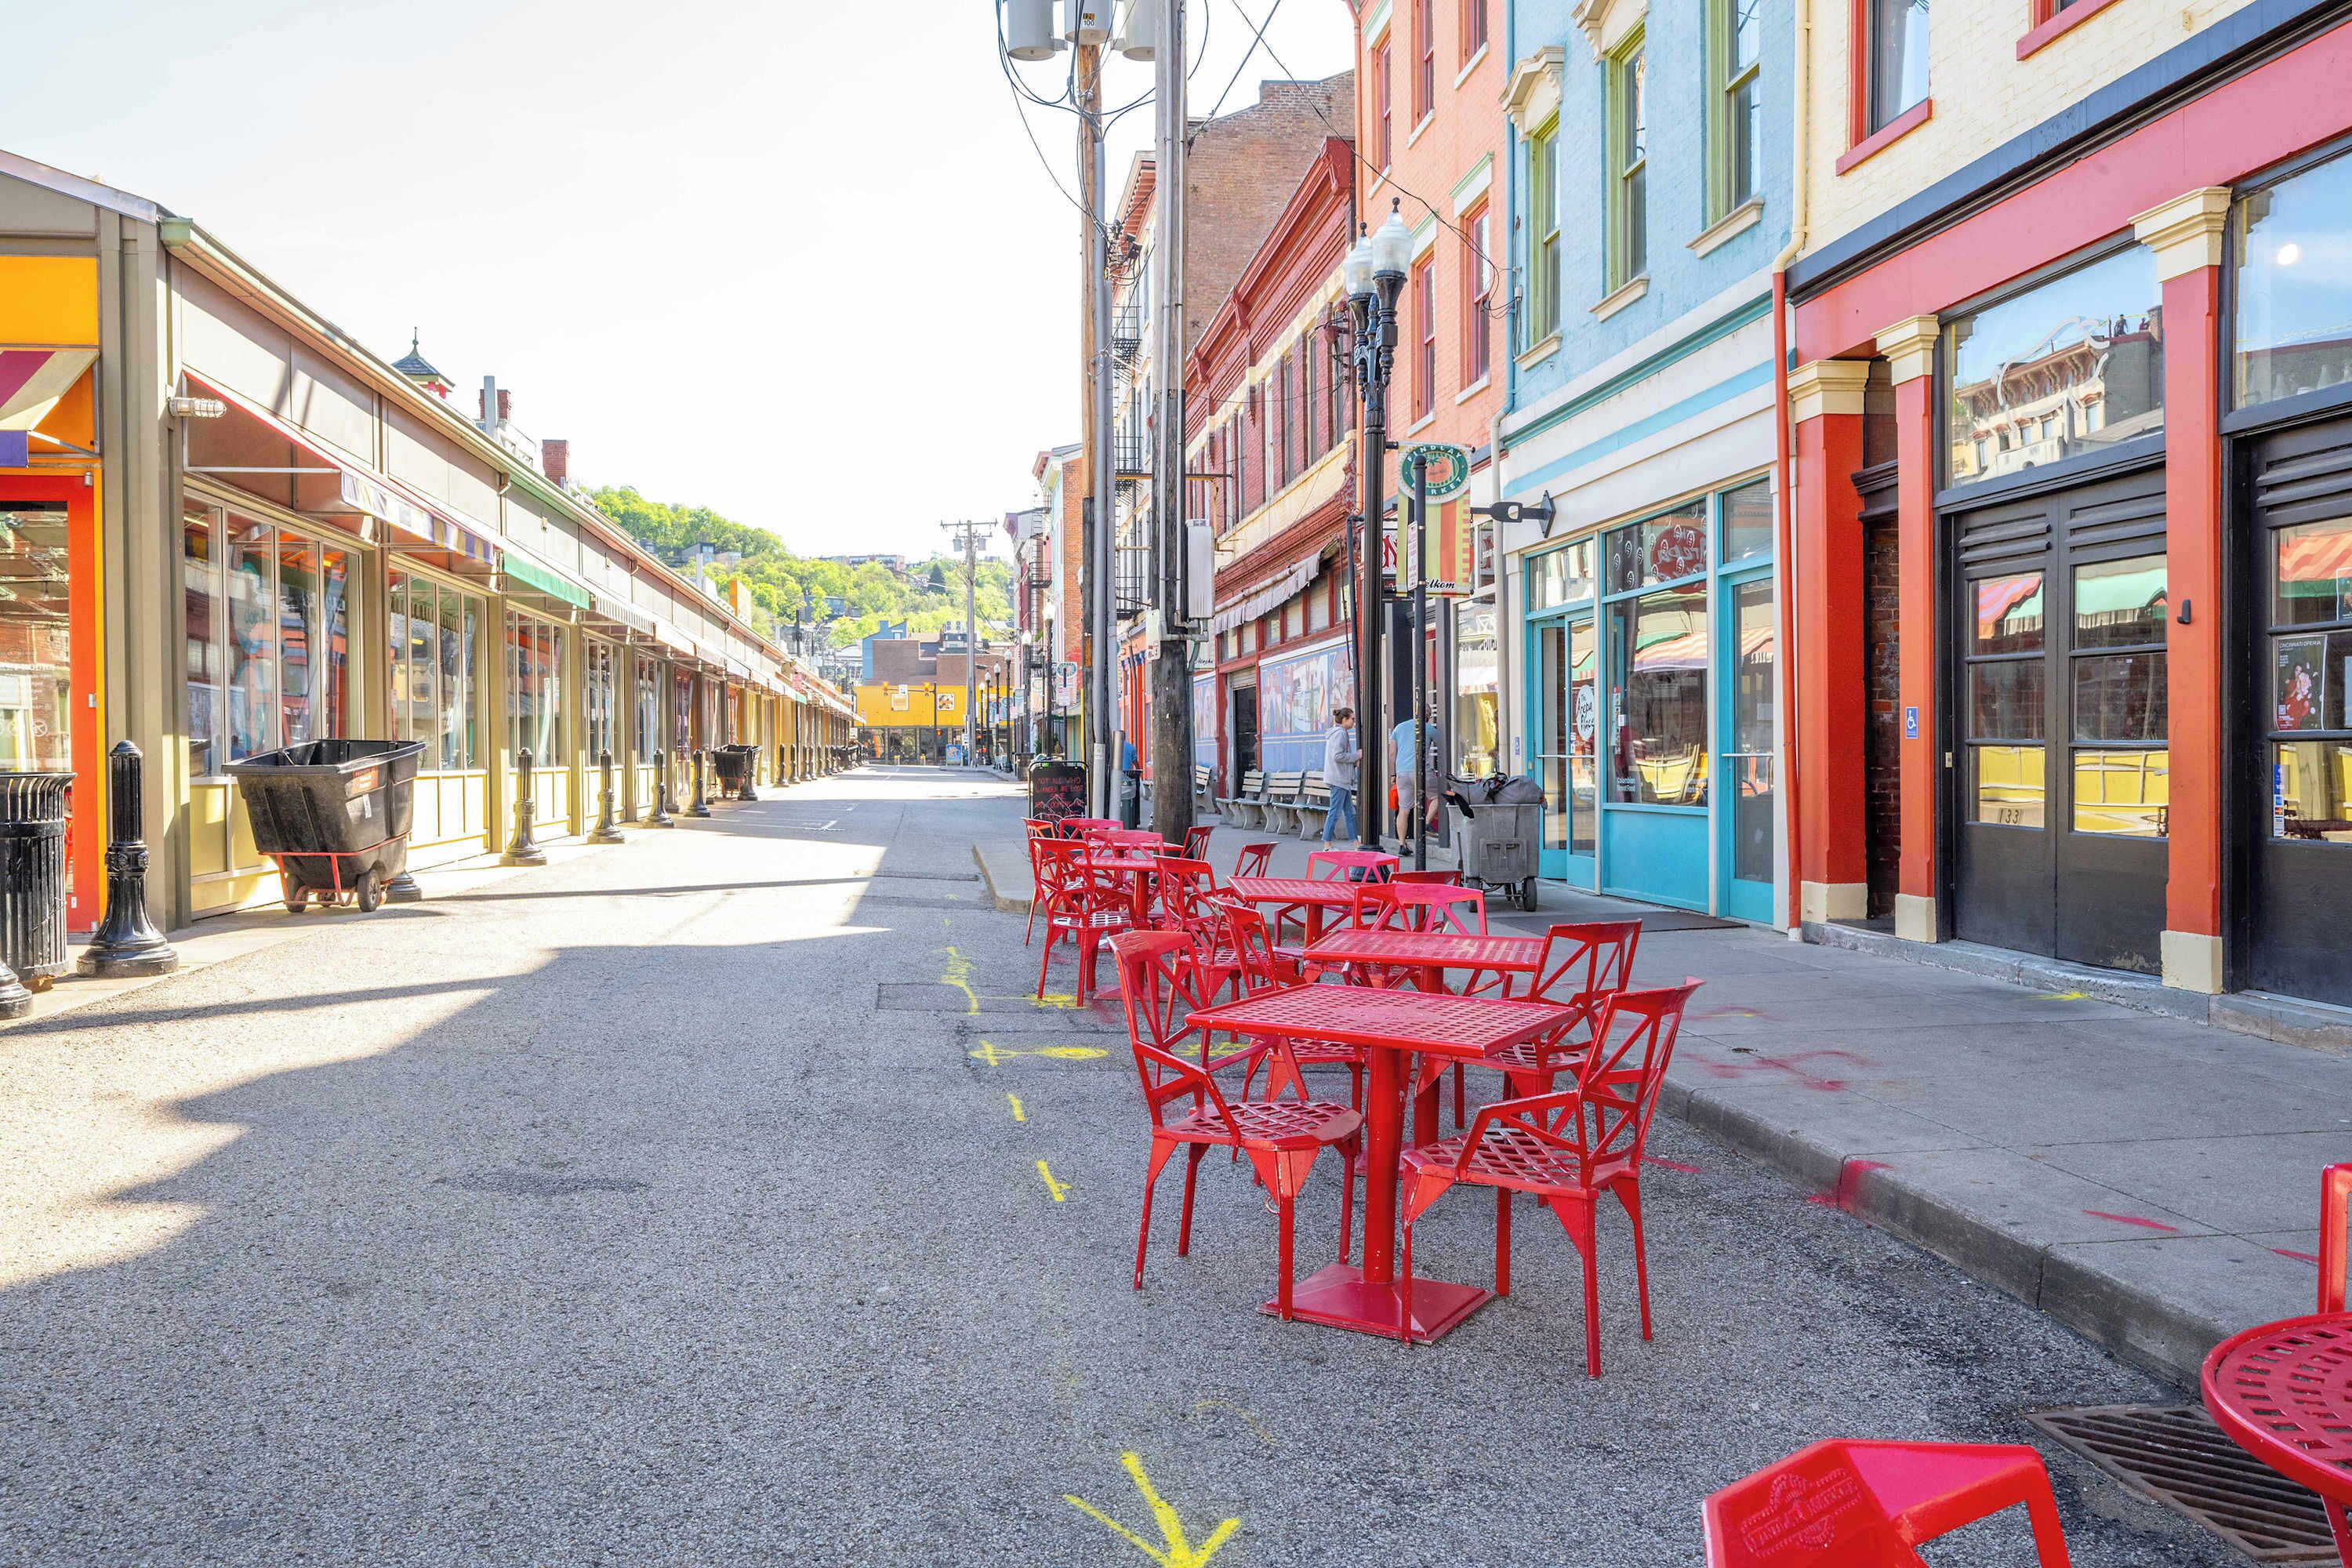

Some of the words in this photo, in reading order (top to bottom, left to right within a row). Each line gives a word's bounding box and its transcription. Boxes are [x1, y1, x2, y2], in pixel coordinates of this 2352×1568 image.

[1407, 445, 1462, 462] FINDLAY
[1425, 578, 1455, 589] elkom
[1999, 808, 2019, 824] 133
